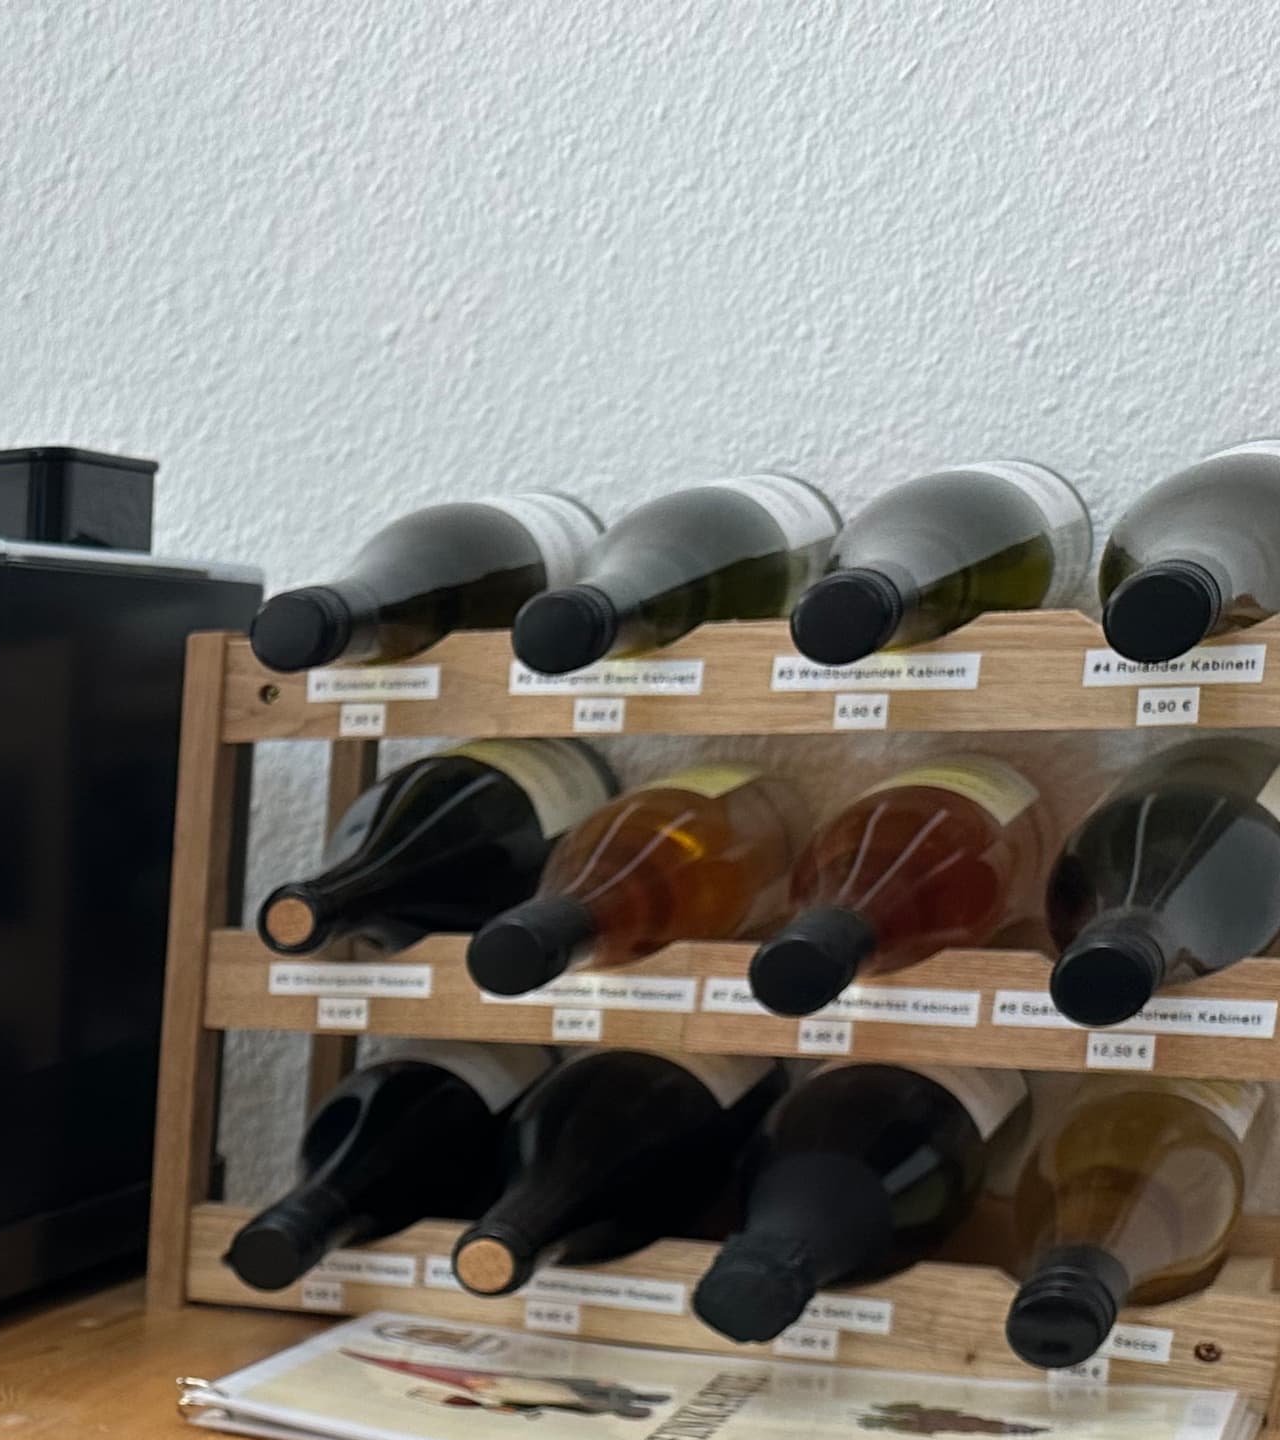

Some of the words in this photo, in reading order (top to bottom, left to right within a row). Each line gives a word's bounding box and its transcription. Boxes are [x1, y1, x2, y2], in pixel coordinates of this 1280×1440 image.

[906, 665, 967, 679] Kabinett
[1093, 663, 1111, 674] #4
[1191, 658, 1257, 673] Kabinett
[1197, 1012, 1262, 1026] Kabinett
